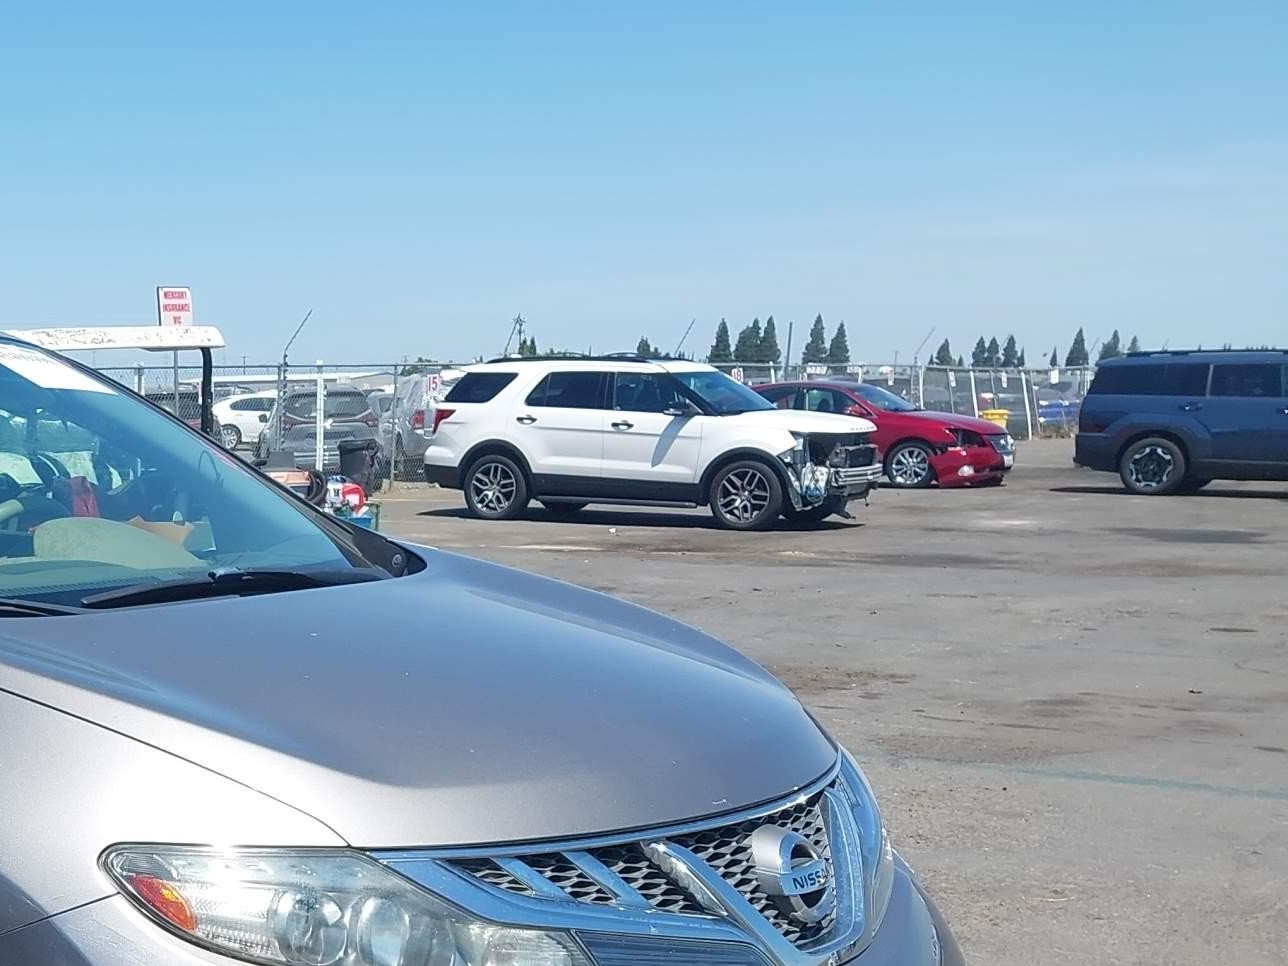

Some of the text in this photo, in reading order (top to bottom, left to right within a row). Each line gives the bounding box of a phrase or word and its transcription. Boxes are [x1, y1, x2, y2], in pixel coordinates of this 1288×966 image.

[163, 290, 187, 300] MERCURY
[162, 303, 191, 313] INSURANCE
[428, 375, 438, 392] 15
